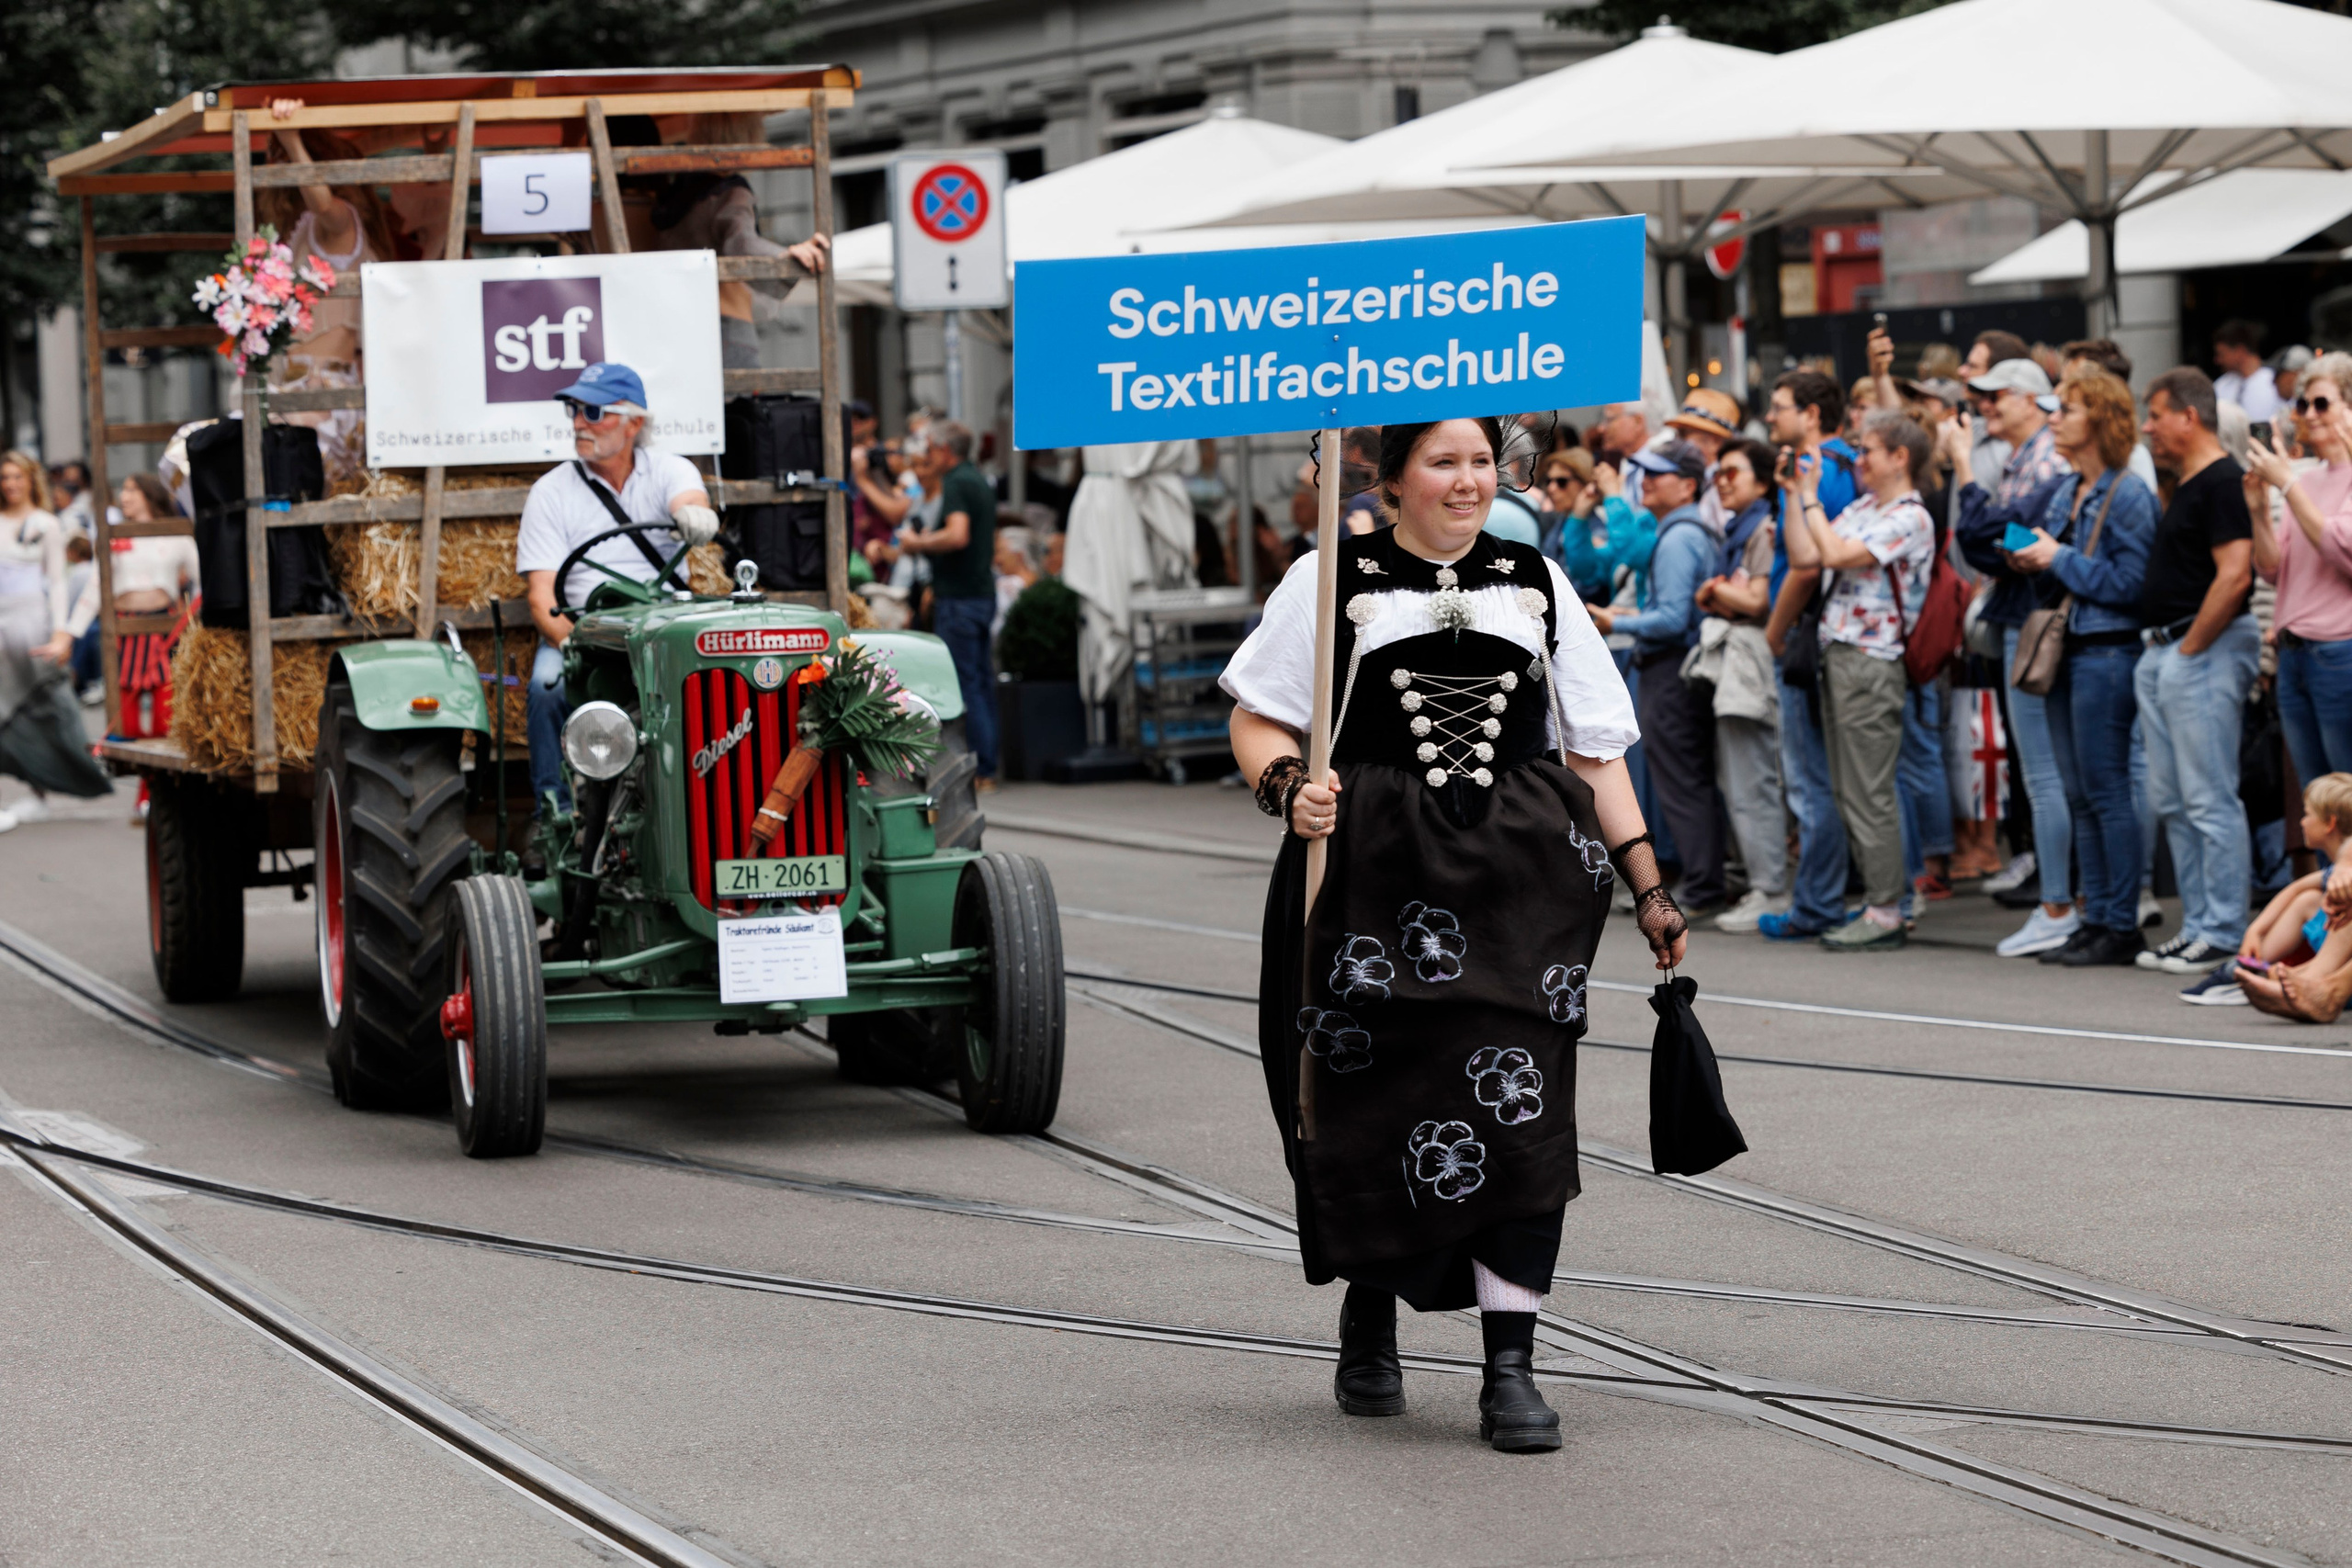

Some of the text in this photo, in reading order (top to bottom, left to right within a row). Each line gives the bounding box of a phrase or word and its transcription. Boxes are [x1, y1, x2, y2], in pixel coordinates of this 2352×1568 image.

[523, 174, 549, 216] 5
[1107, 262, 1559, 339] Schweizerische
[493, 306, 594, 373] stf
[1098, 332, 1565, 412] Textilfachschule
[376, 428, 532, 447] Schweizerische
[704, 631, 824, 652] Hürlimann
[693, 707, 753, 778] Diesel
[775, 862, 830, 887] 2061
